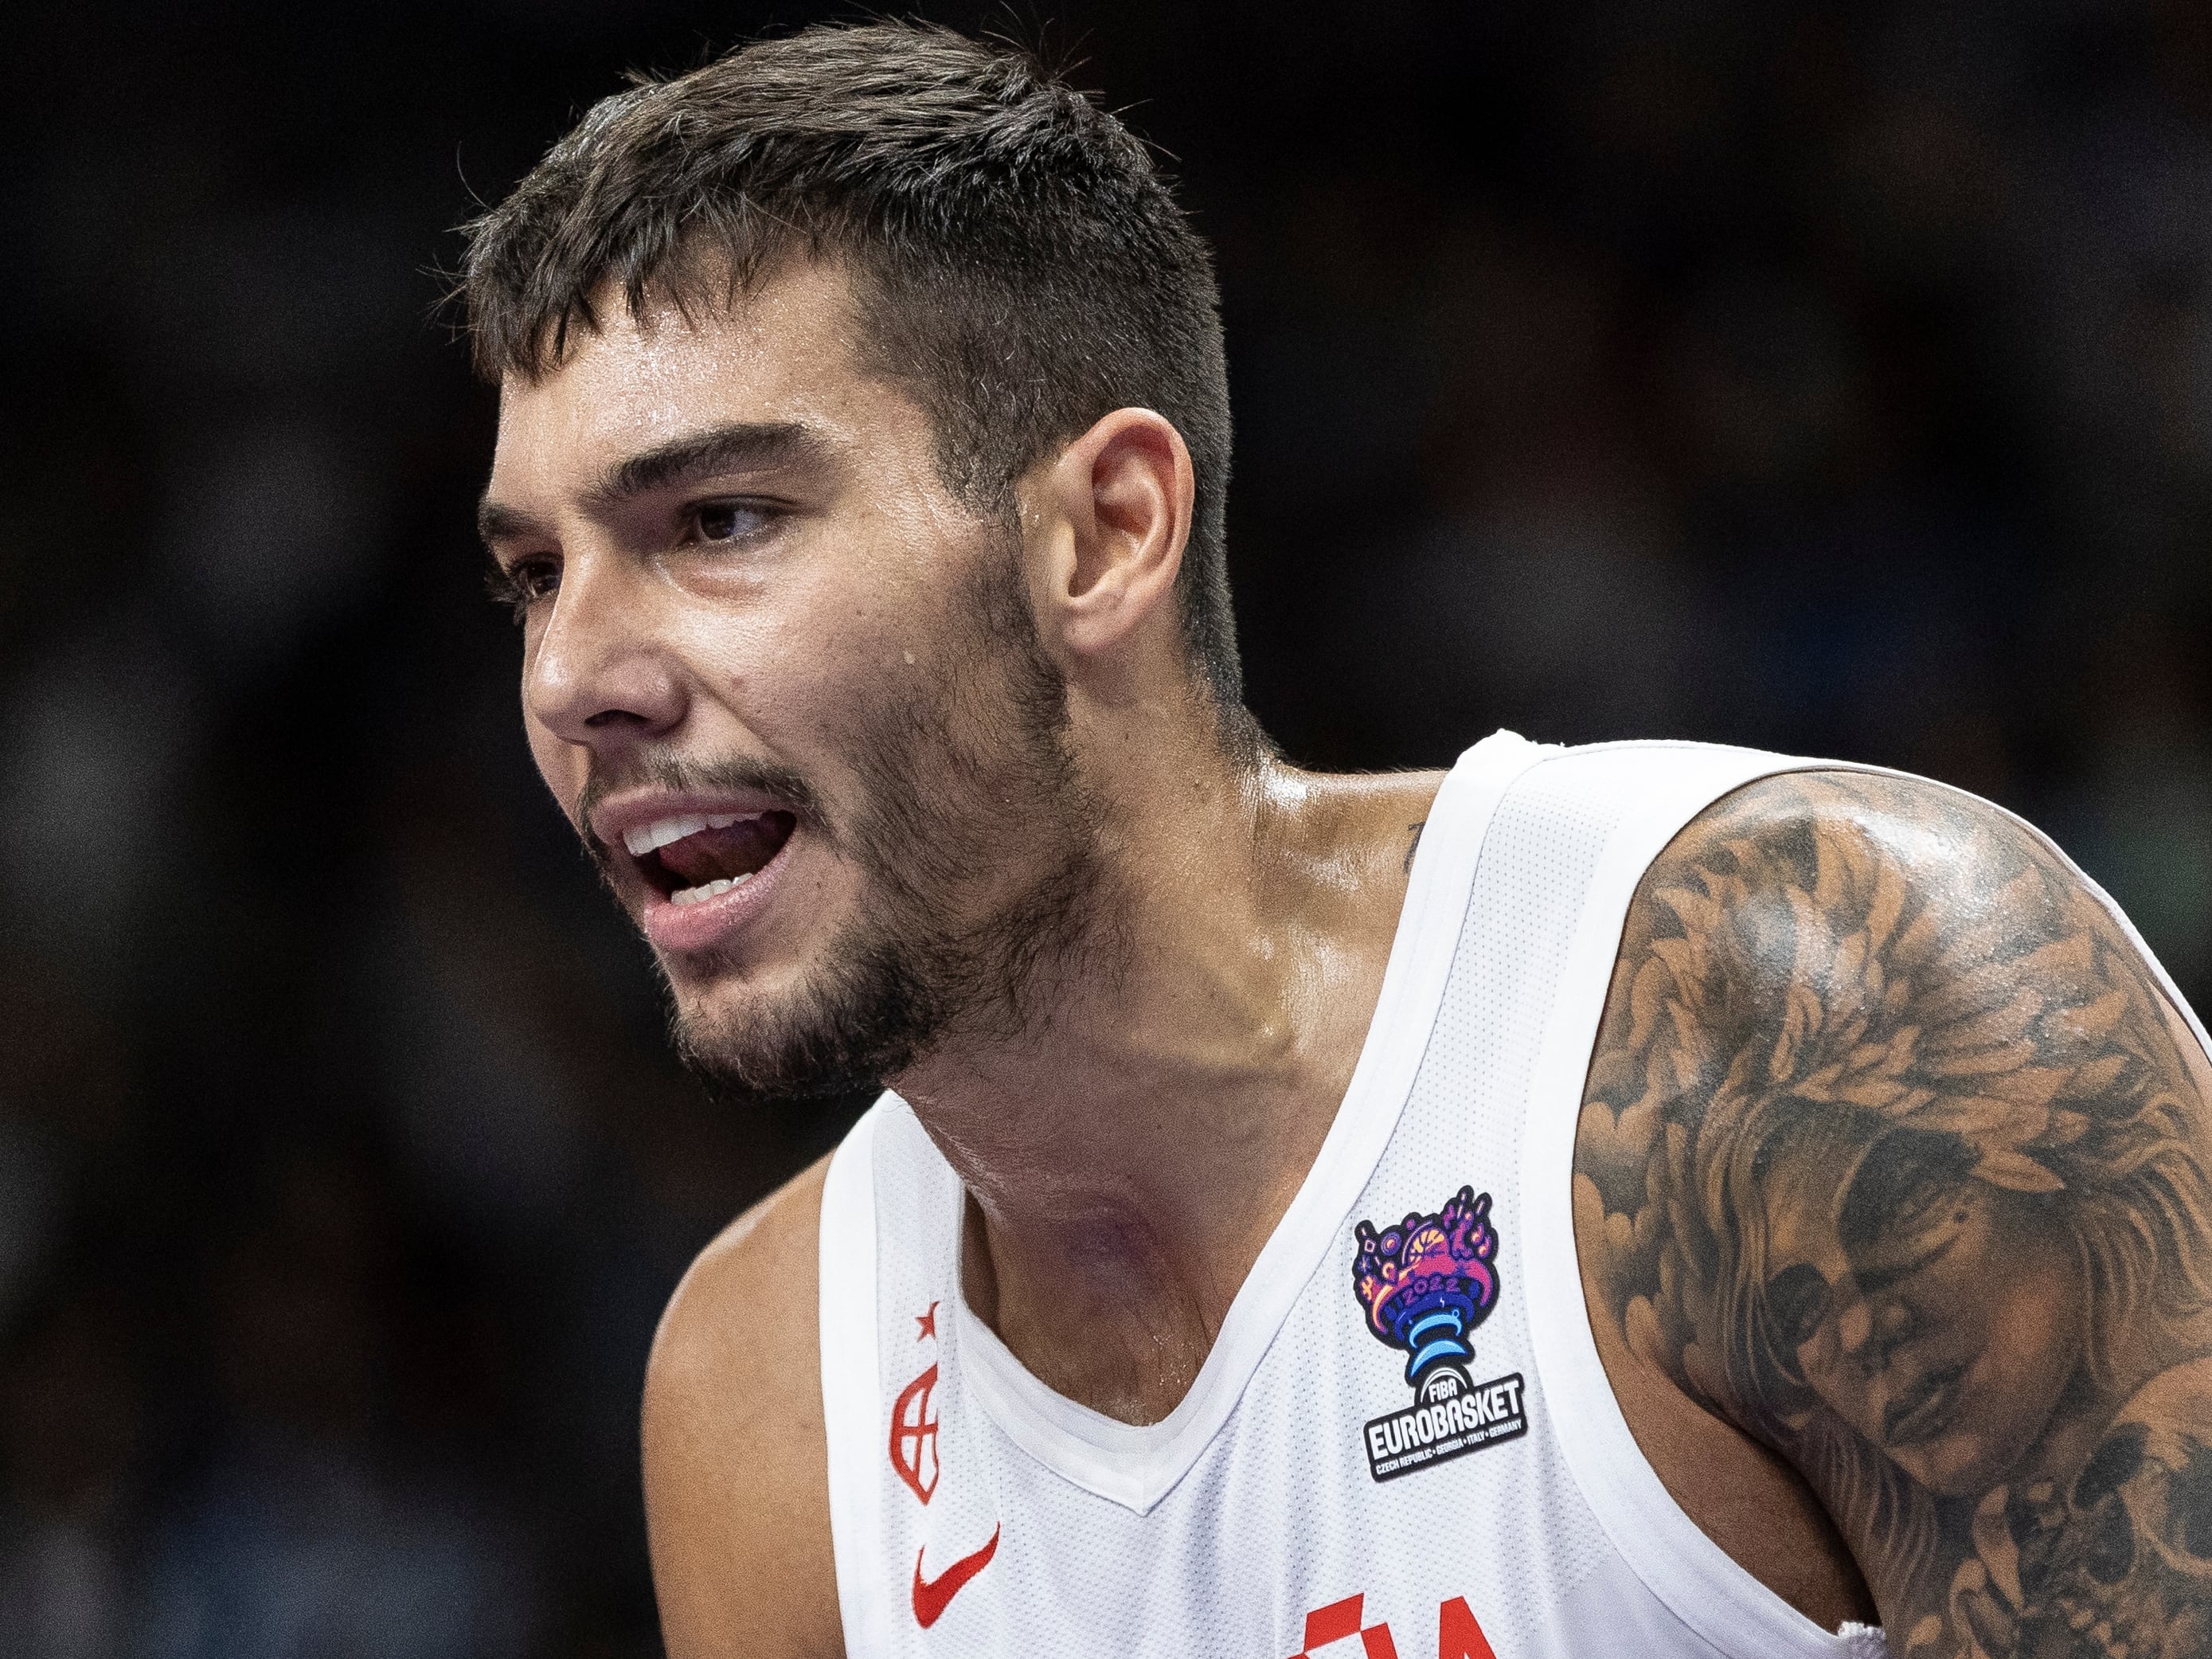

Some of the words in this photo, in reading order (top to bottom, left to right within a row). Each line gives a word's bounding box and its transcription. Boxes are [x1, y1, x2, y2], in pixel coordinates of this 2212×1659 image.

[1402, 1275, 1461, 1306] 2022
[1428, 1378, 1458, 1403] FIBA
[1368, 1379, 1520, 1461] EUROBASKET
[1376, 1459, 1400, 1475] CZECH
[1399, 1448, 1434, 1468] REPUBLIC
[1467, 1430, 1485, 1446] ITALY
[1488, 1418, 1522, 1438] GERMANY
